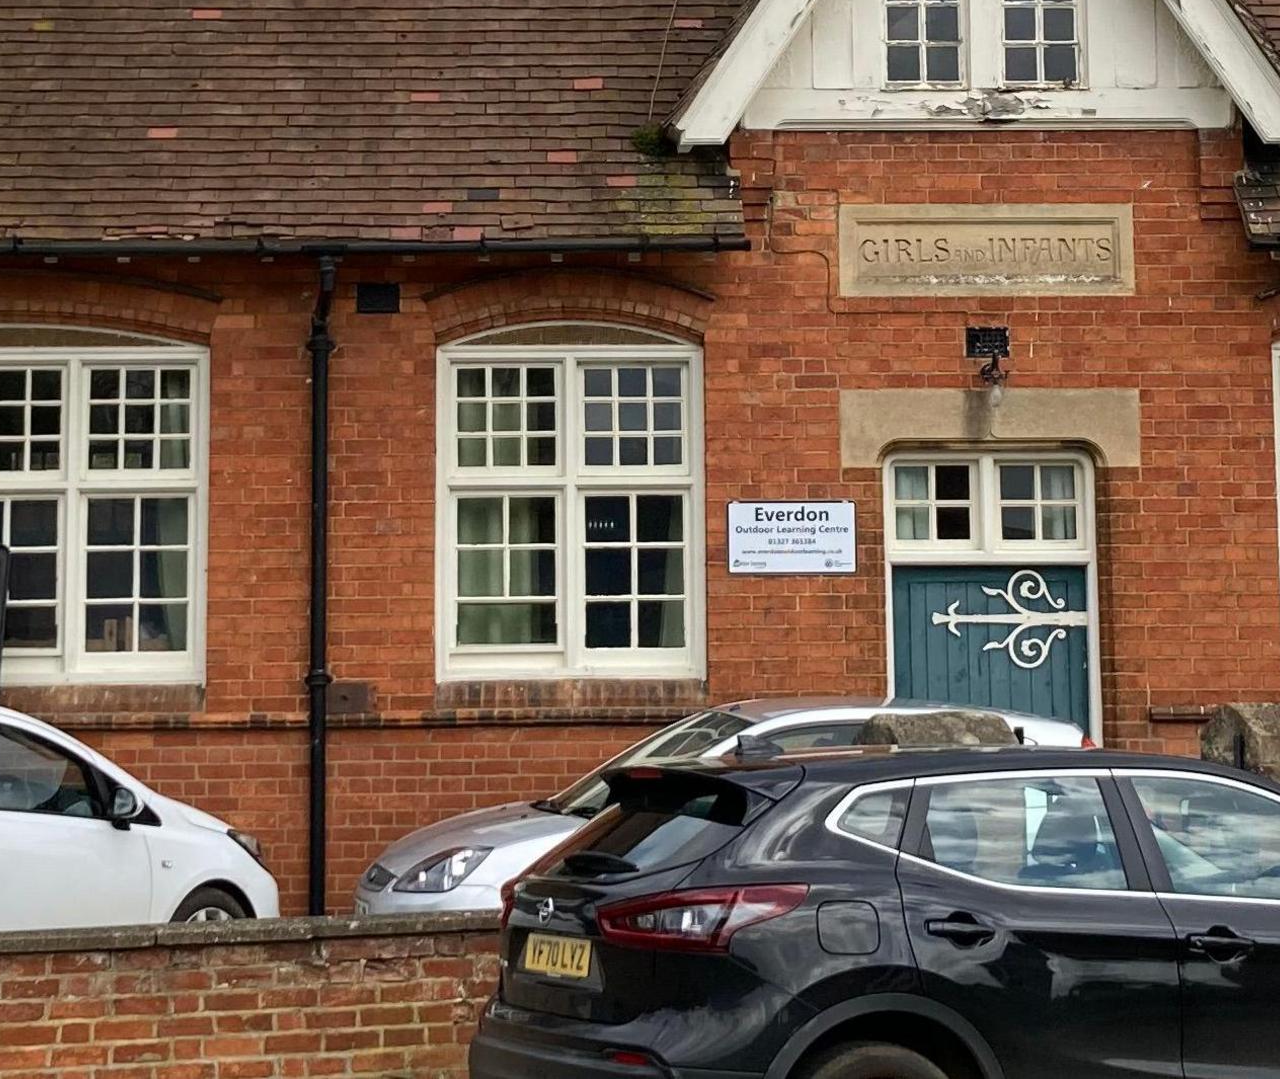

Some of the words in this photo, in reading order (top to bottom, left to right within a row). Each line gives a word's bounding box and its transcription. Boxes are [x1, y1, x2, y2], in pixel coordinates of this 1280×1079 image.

[858, 237, 951, 264] GIRLS
[953, 248, 987, 263] AND
[988, 237, 1113, 265] INFANTS
[754, 506, 830, 522] Everdon
[735, 525, 773, 534] Outdoor
[776, 525, 816, 535] Learning
[818, 524, 849, 533] Centre
